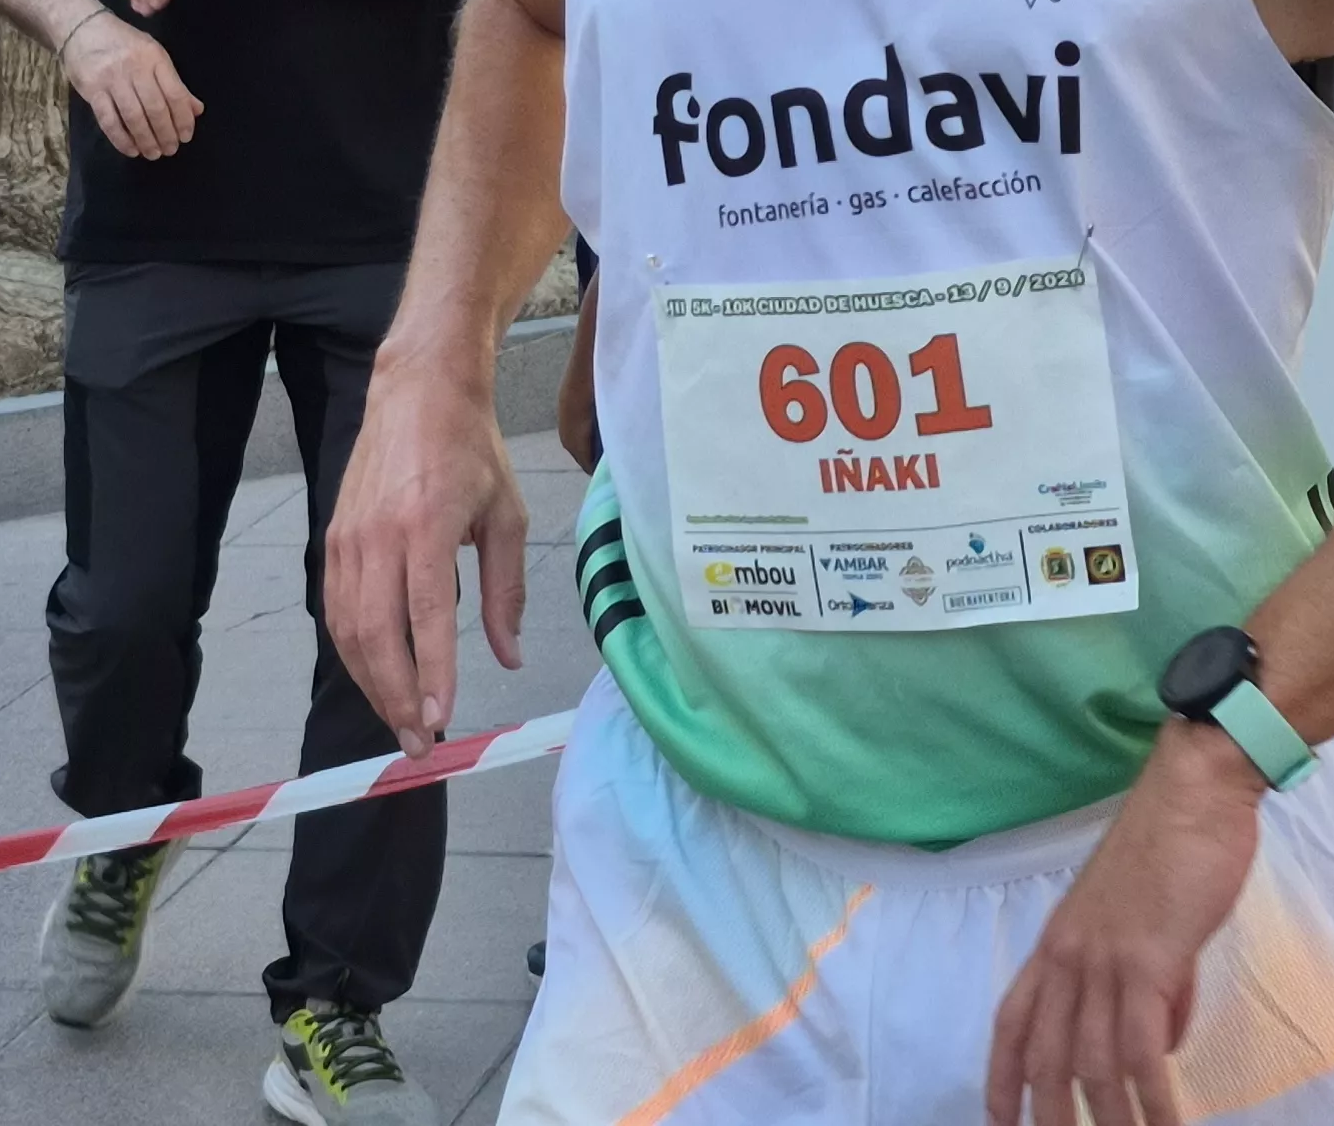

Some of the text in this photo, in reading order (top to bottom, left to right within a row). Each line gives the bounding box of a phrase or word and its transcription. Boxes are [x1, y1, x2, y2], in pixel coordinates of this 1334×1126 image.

[653, 40, 1082, 186] fondavi
[718, 169, 1042, 229] fontanería gas calefacción
[756, 295, 823, 315] CIUDAD
[824, 294, 851, 314] DE
[853, 288, 935, 313] HUESCA
[758, 332, 994, 444] 601
[818, 448, 941, 494] IÑAKI
[834, 556, 889, 572] AMBAR
